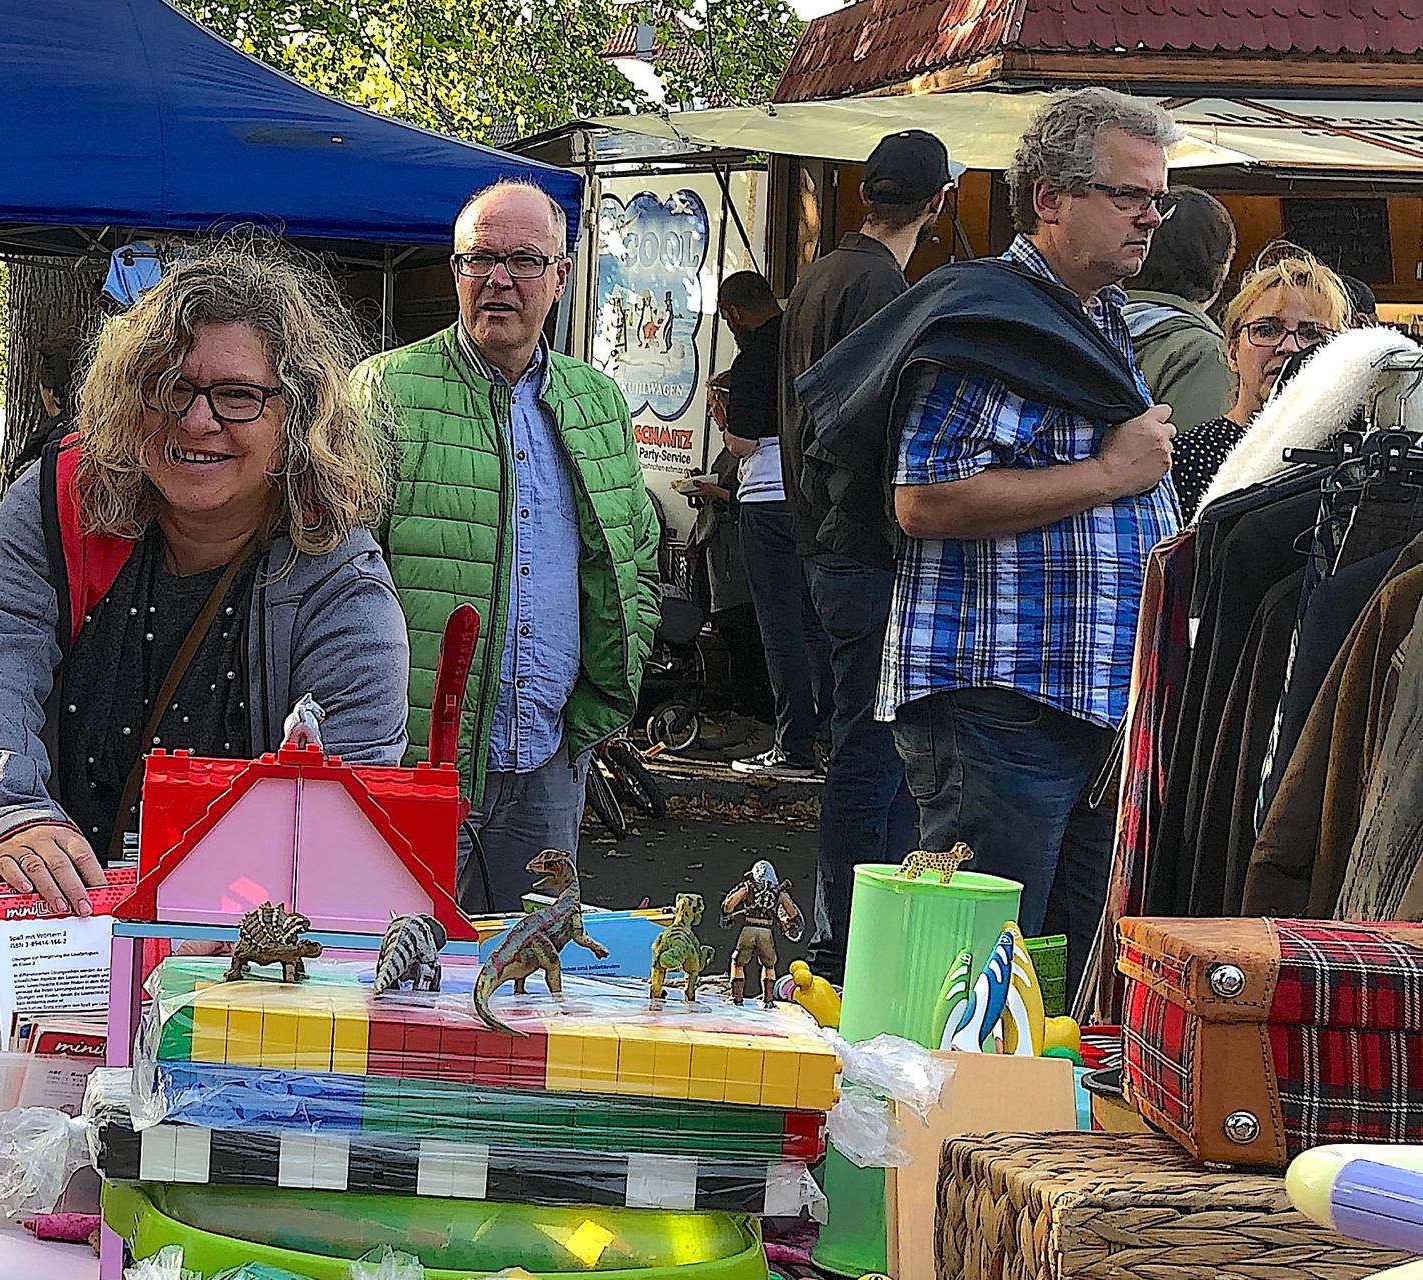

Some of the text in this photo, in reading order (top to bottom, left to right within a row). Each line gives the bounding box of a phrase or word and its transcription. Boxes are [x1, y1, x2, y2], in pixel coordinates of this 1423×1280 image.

[622, 231, 699, 267] COOL
[634, 424, 693, 449] SCHMITZ
[639, 447, 691, 464] Party-Service
